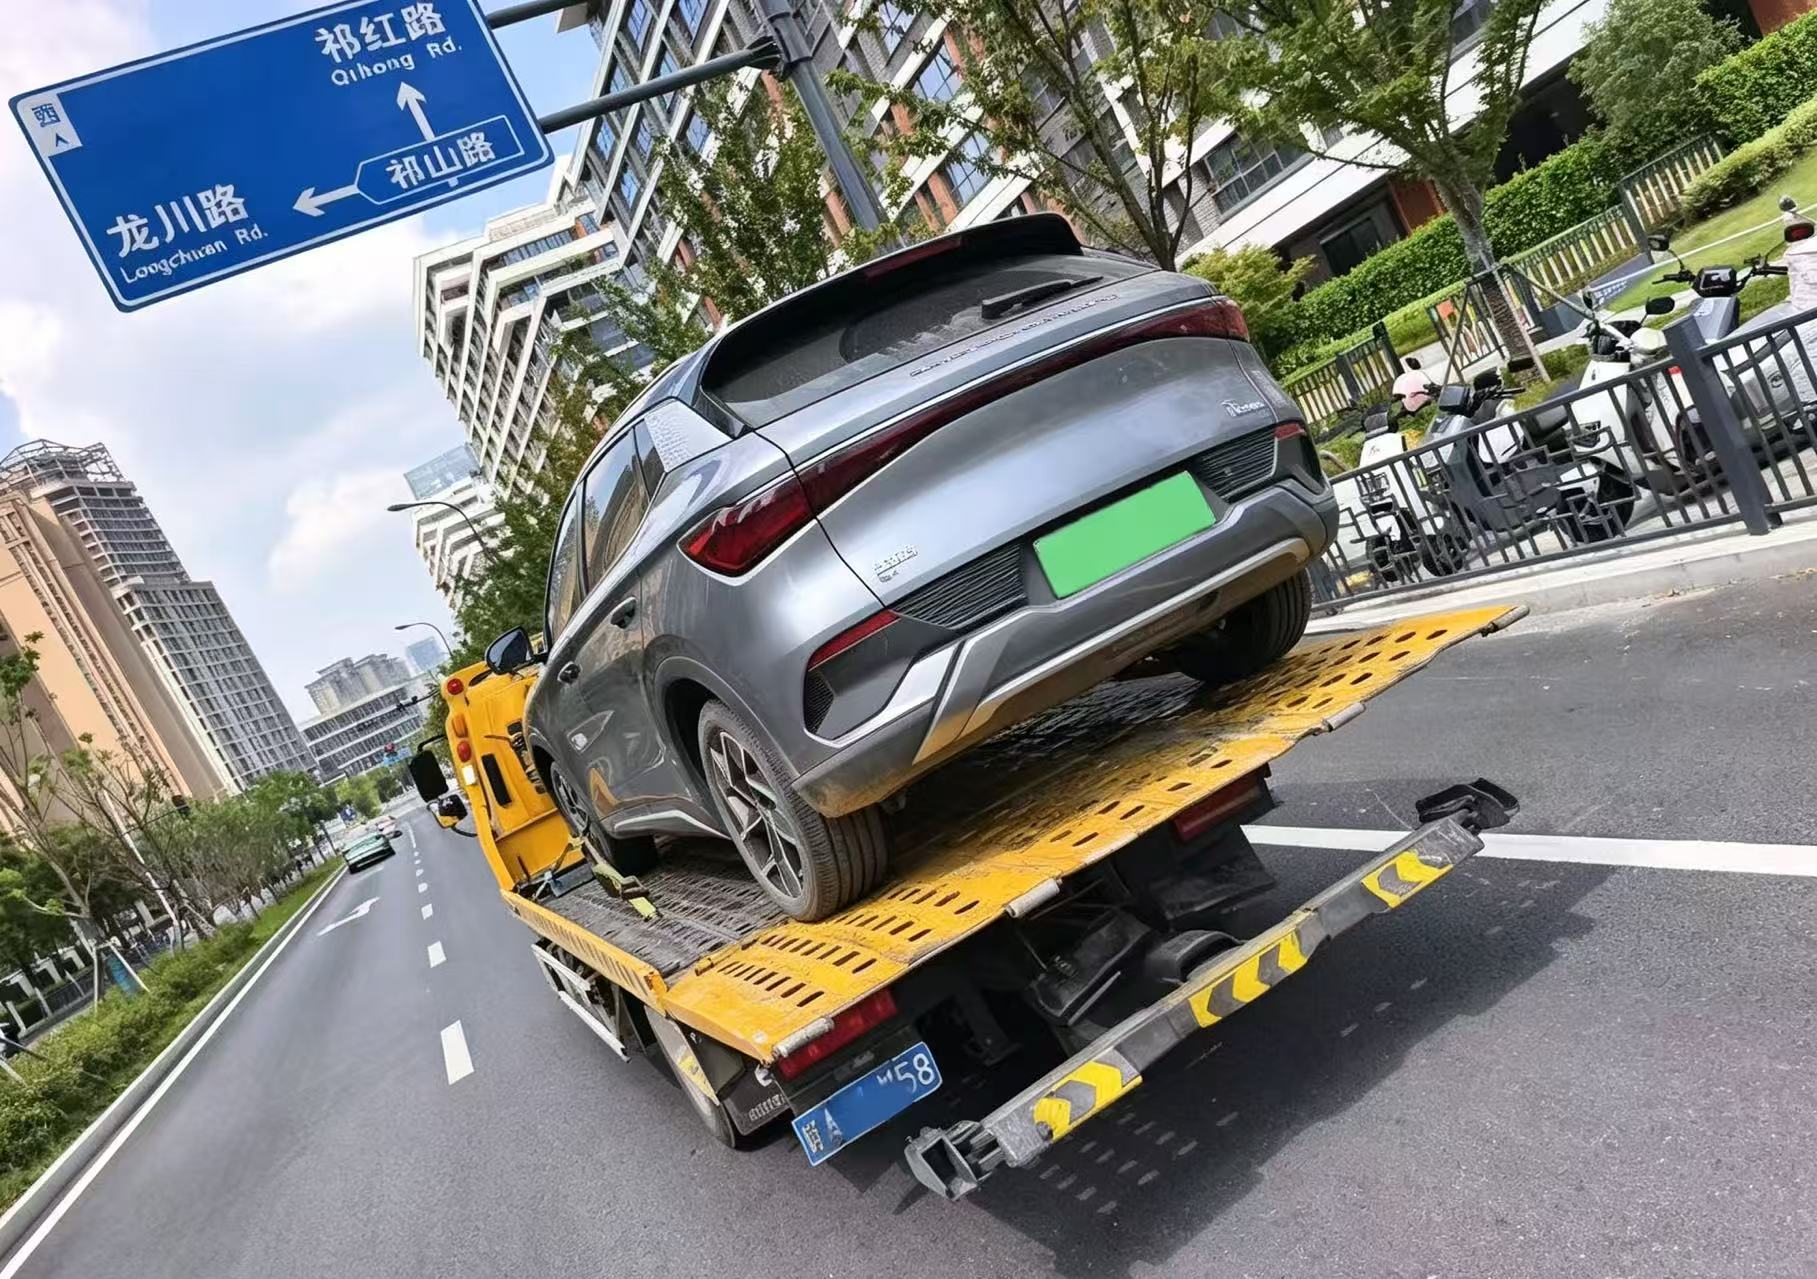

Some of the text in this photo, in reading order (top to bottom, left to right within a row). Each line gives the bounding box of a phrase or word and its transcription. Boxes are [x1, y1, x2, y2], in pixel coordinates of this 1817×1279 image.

[315, 2, 447, 63] 祁红路
[331, 36, 463, 86] Qihong Rd.
[31, 103, 61, 127] 西
[385, 132, 496, 189] 祁山路
[106, 184, 249, 258] 龙川路
[234, 223, 268, 245] Rd.
